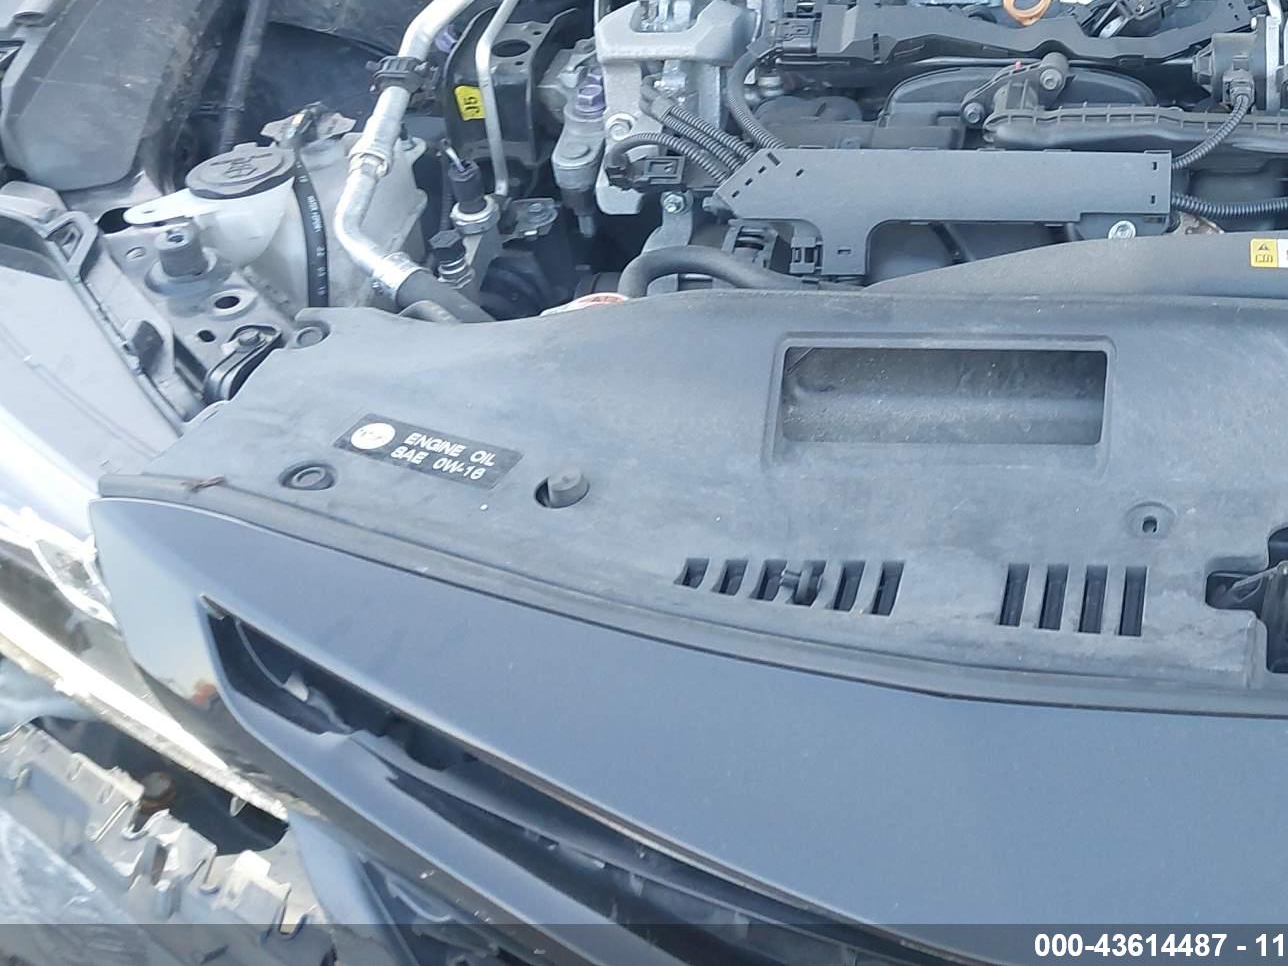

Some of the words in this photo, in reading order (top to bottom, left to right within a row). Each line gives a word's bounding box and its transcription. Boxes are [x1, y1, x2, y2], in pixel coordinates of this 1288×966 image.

[391, 446, 430, 465] SAE
[403, 432, 467, 457] ENGINE
[469, 450, 498, 467] OIL
